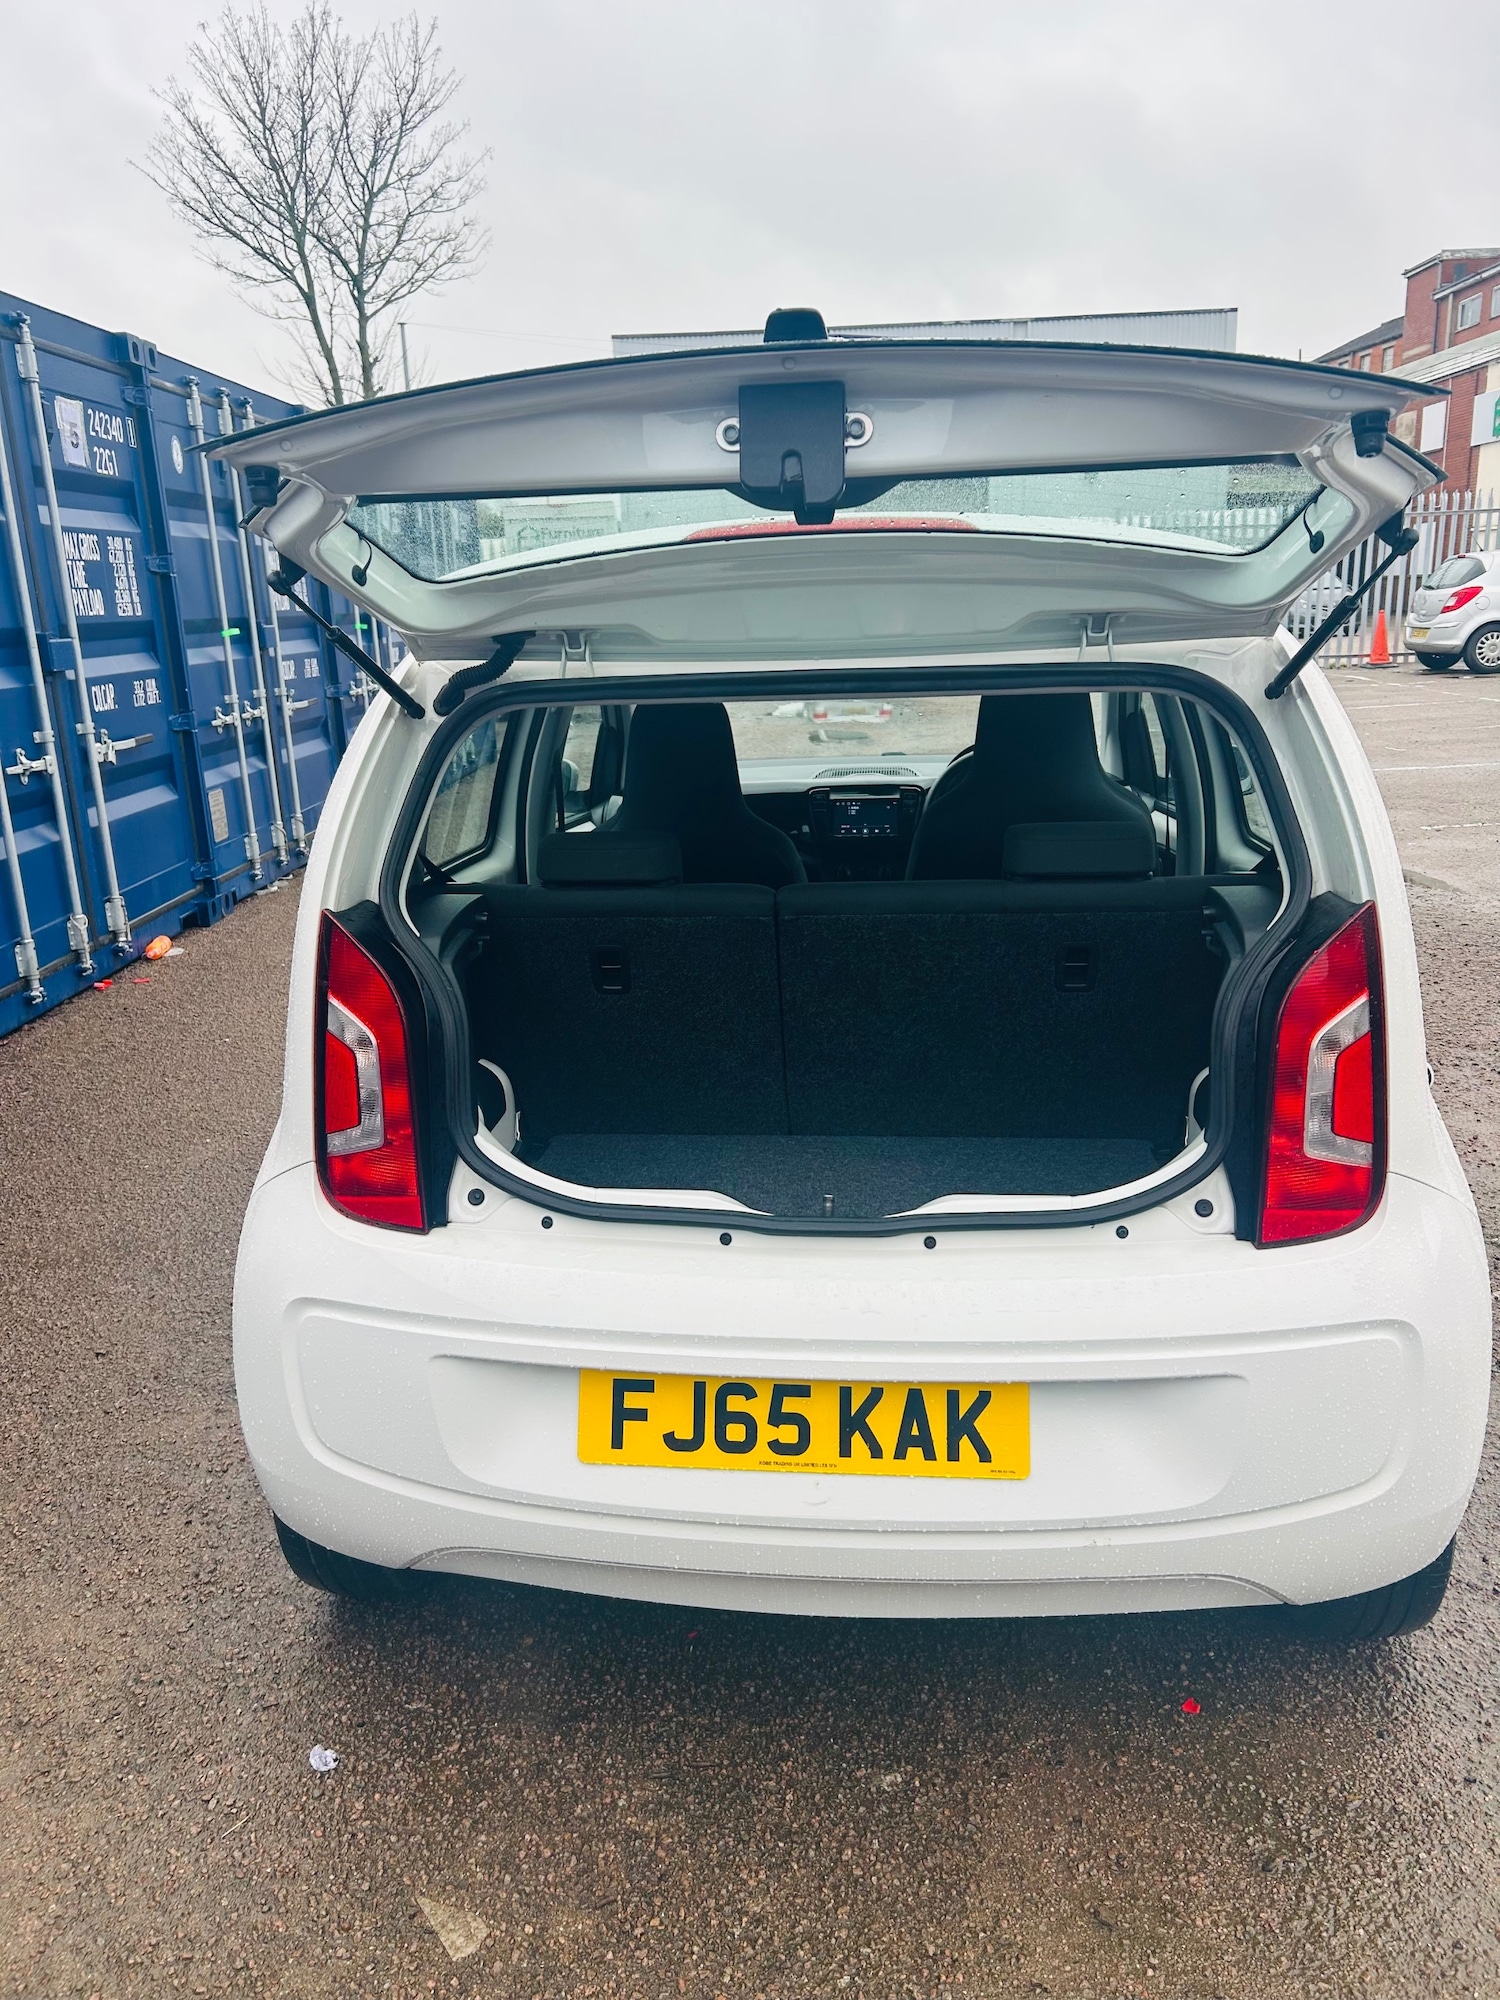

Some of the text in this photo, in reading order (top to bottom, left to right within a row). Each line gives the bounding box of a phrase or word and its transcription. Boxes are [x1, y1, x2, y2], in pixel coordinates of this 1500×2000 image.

[87, 408, 124, 443] 242340
[93, 446, 119, 477] 22G1
[63, 531, 80, 560] MAX
[79, 532, 101, 561] GROSS
[66, 560, 89, 588] TARE
[71, 588, 105, 616] PAYLOAD
[611, 1378, 992, 1463] FJ65 KAK
